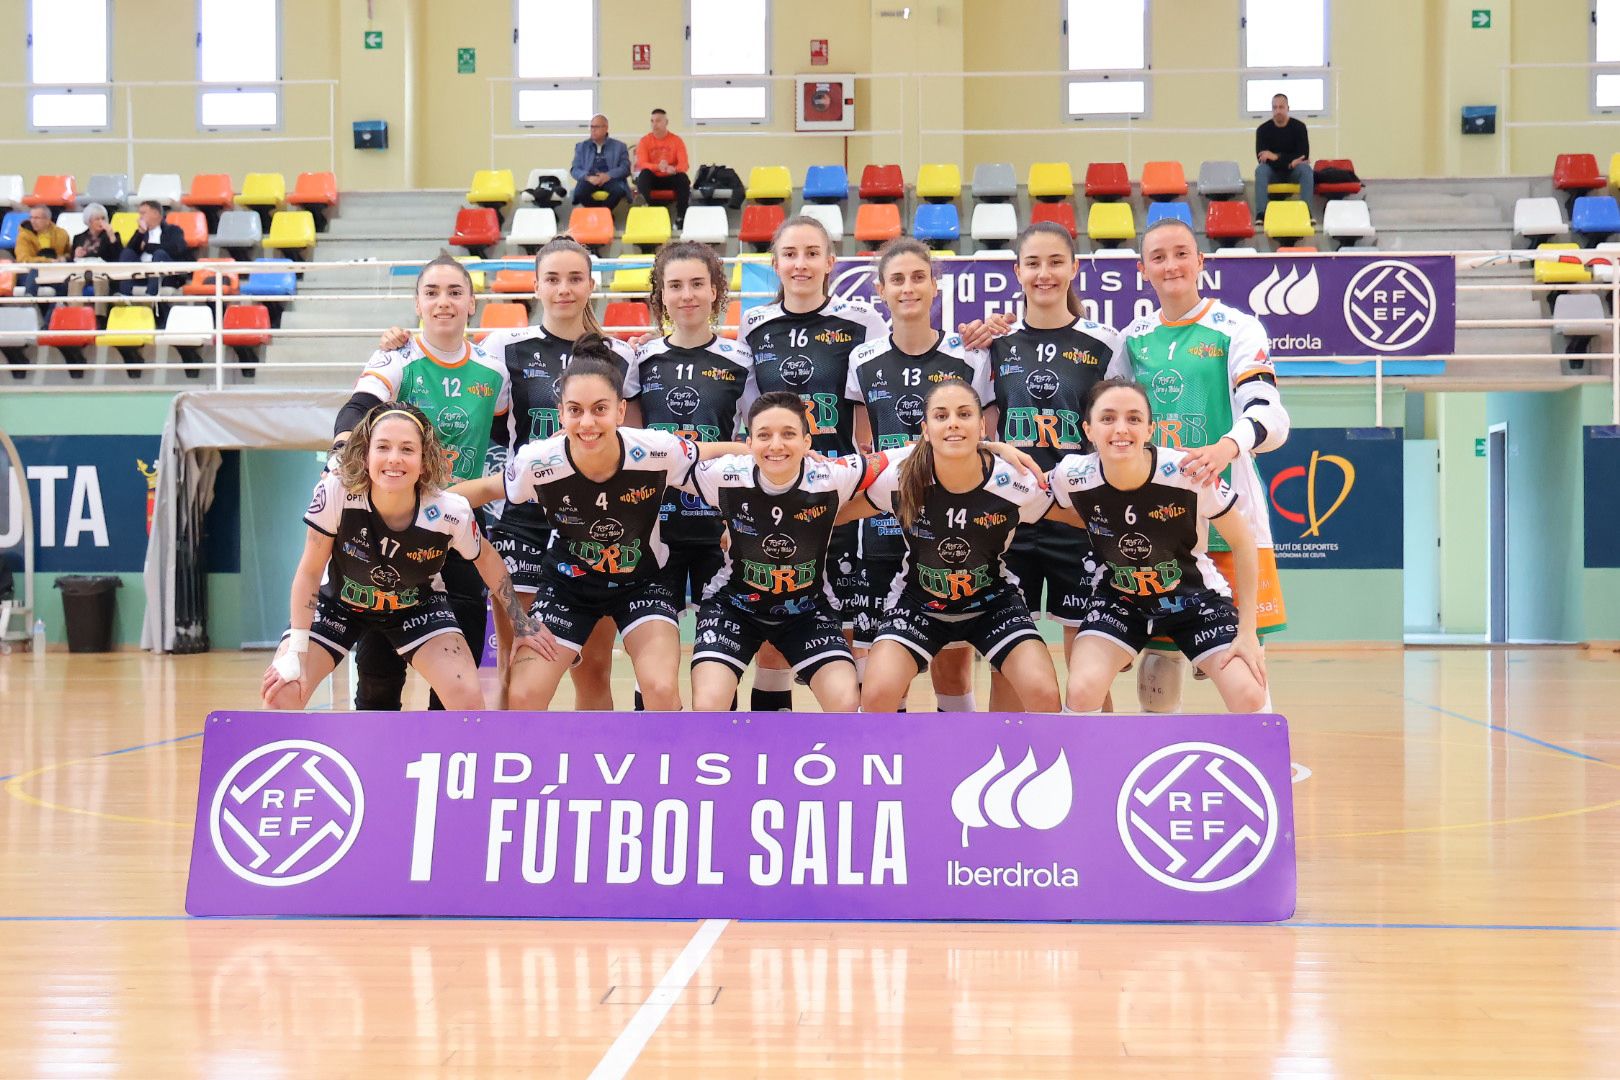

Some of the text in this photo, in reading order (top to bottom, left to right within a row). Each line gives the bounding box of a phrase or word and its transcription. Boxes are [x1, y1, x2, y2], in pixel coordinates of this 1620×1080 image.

[984, 272, 1222, 292] DISIN
[788, 328, 809, 347] 16
[1266, 334, 1322, 350] erdrola
[1036, 343, 1057, 362] 19
[1167, 341, 1177, 360] 1
[675, 363, 694, 380] 11
[901, 367, 922, 387] 13
[441, 376, 461, 397] 12
[534, 468, 554, 479] OPTI
[723, 473, 740, 481] OPTI
[1068, 476, 1087, 486] OPTI
[595, 492, 608, 511] 4
[771, 506, 783, 526] 9
[945, 507, 967, 530] 14
[1124, 505, 1137, 525] 6
[379, 536, 400, 558] 17
[1273, 542, 1339, 551] EUTÍ DE DEPORTES
[519, 559, 543, 573] Moren
[804, 635, 849, 650] Ahyre
[261, 788, 316, 809] RF
[1168, 791, 1225, 812] RF
[405, 742, 903, 882] 1ª DIVISIÓN
[258, 816, 313, 837] EF
[484, 783, 909, 887] FÚTBOL SALA
[1168, 820, 1225, 840] EF
[946, 860, 1079, 888] Iberdrola
